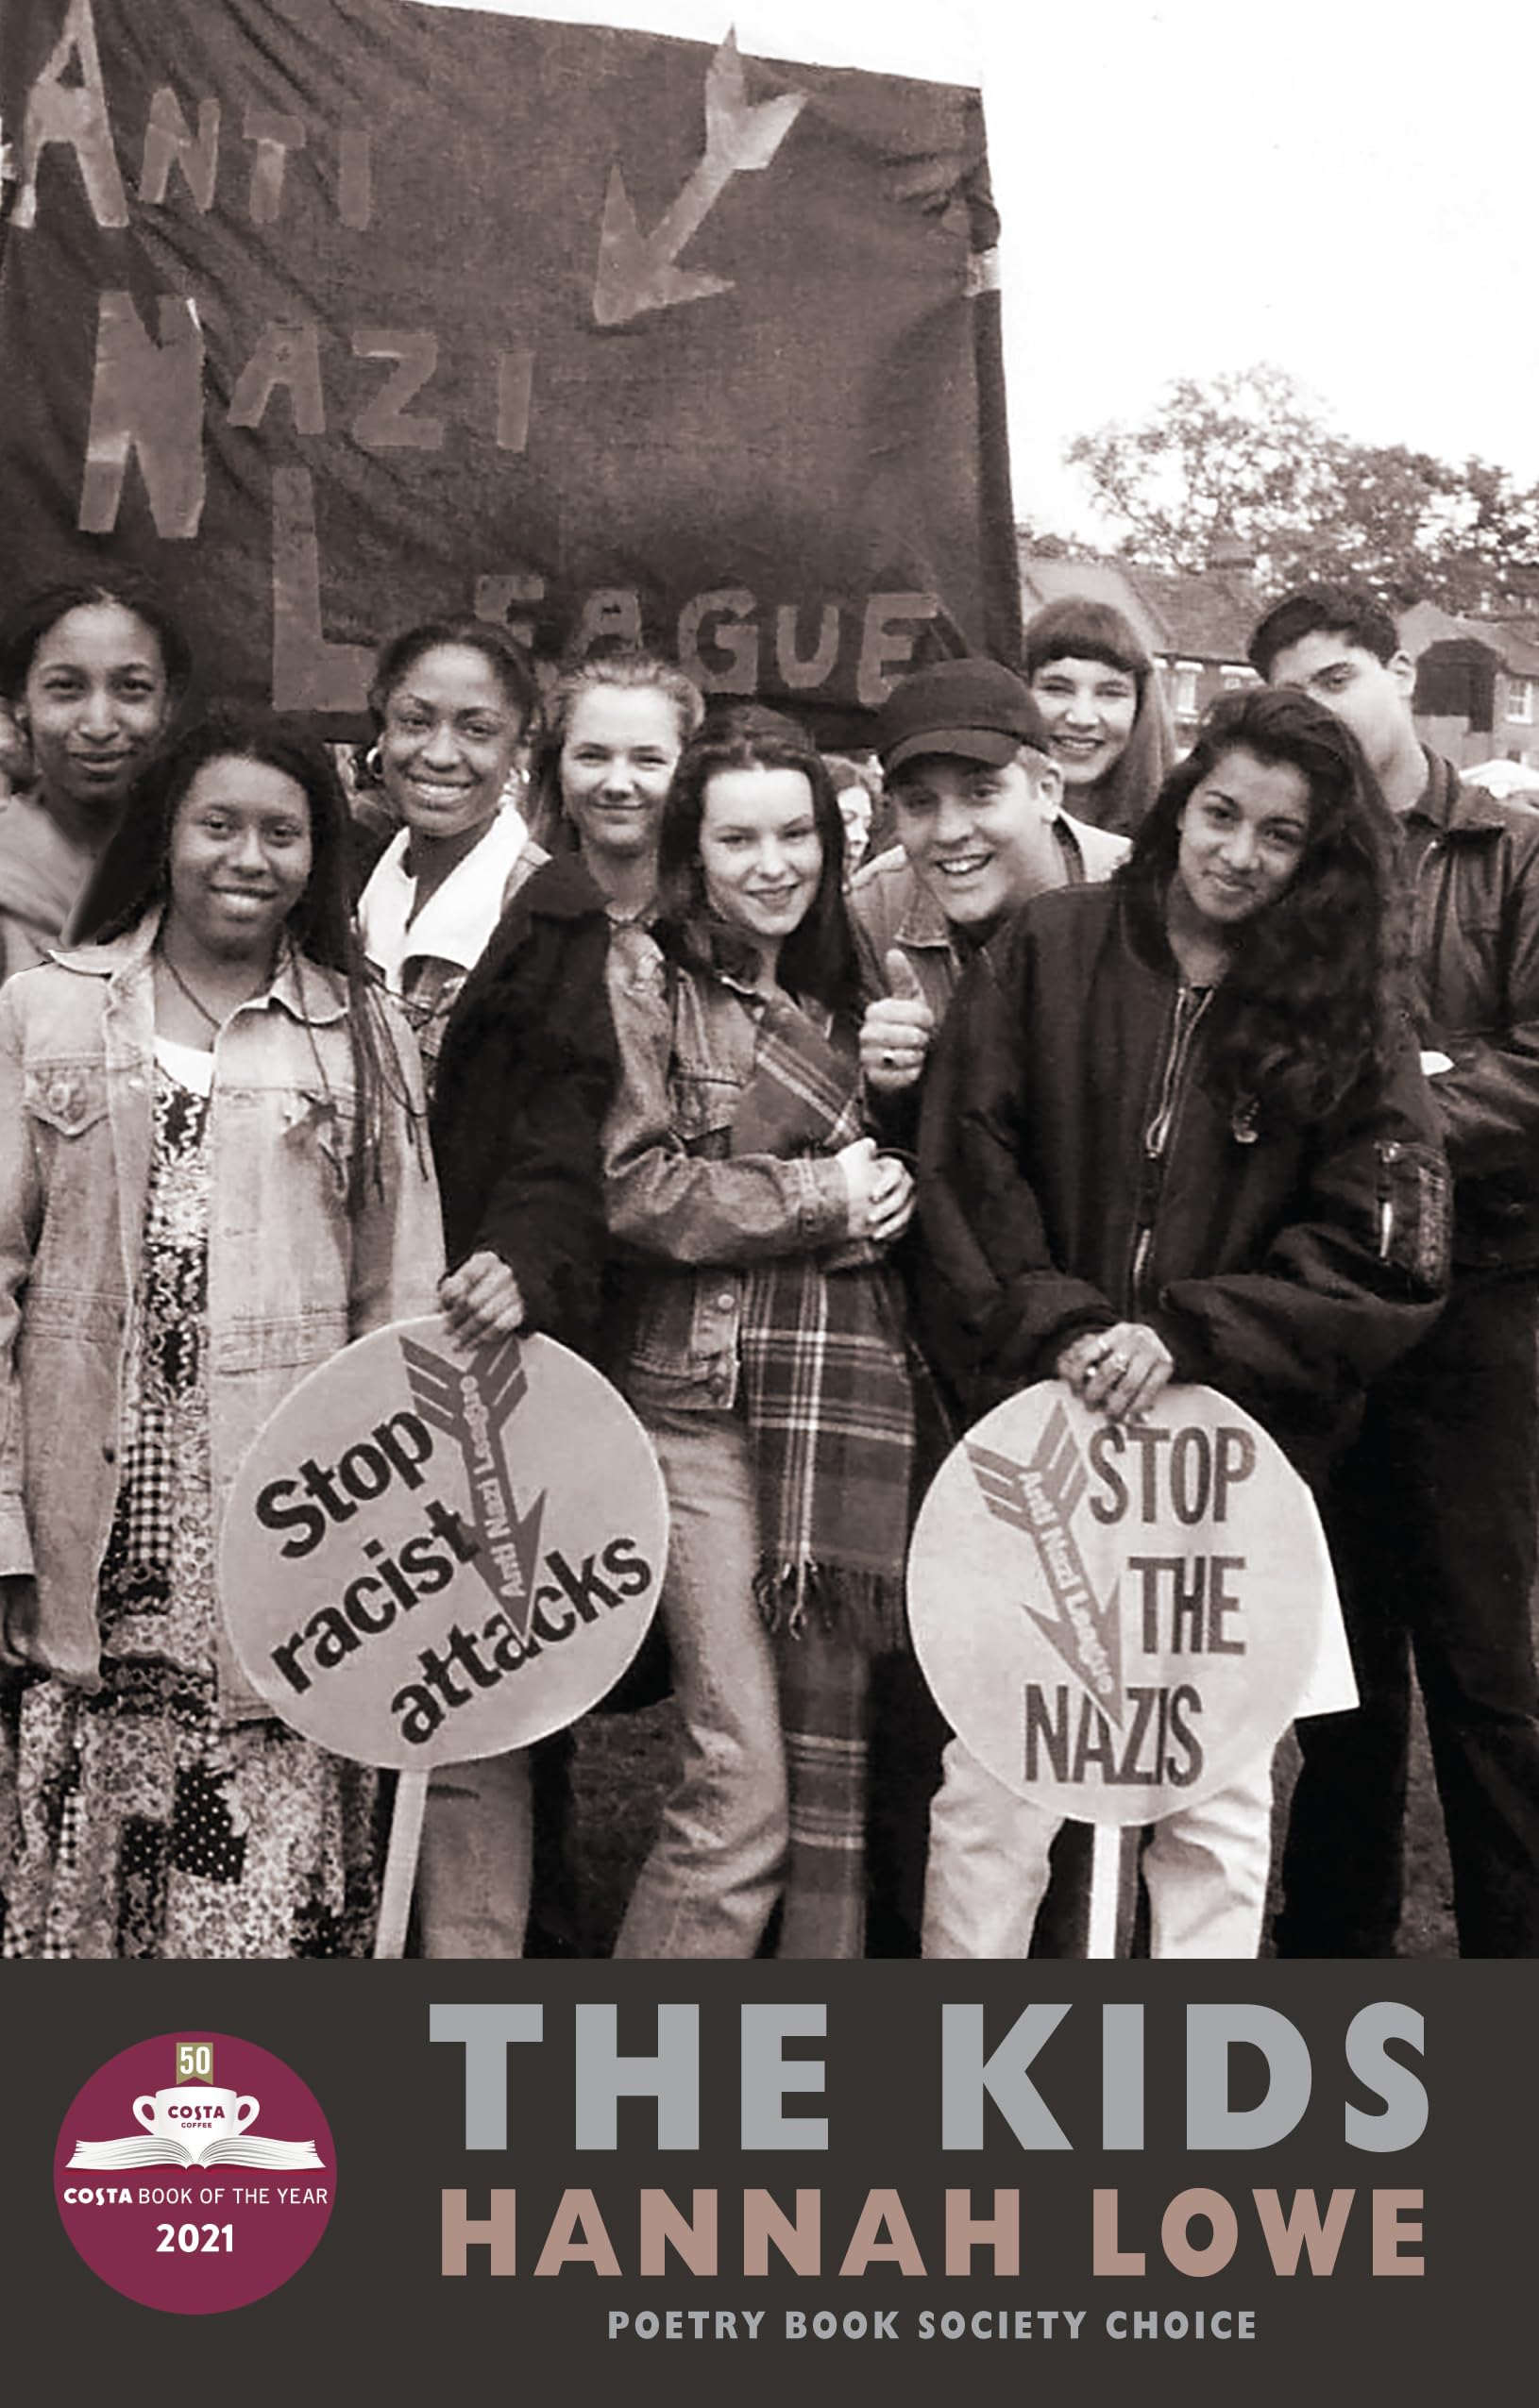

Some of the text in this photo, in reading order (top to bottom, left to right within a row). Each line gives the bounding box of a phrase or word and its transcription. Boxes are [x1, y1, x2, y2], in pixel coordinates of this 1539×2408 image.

[11, 0, 372, 232] ANTI
[78, 290, 535, 539] NAZI
[255, 1411, 433, 1558] Stop
[1089, 1426, 1257, 1524] STOP
[270, 1500, 481, 1694] racist
[391, 1538, 651, 1744] attacks
[1127, 1556, 1246, 1656] THE
[1024, 1684, 1205, 1788] NAZIS
